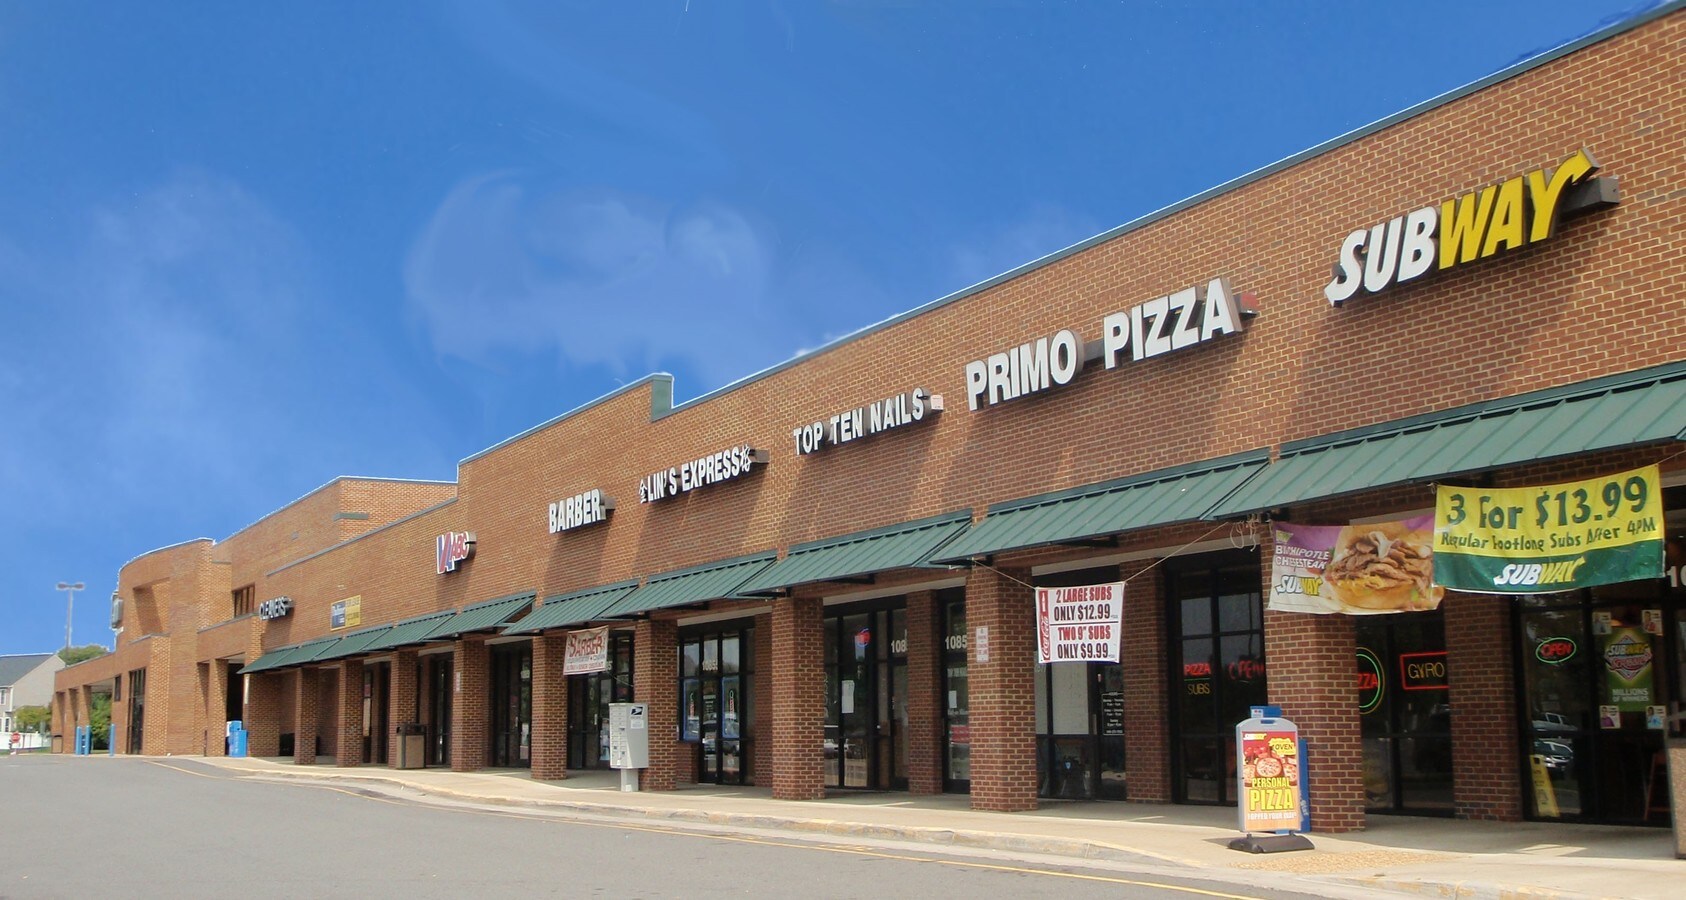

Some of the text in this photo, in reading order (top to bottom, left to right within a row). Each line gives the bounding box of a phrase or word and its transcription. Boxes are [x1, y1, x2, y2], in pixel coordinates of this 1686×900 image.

[1324, 148, 1597, 307] SUBWAY
[965, 277, 1238, 411] PRIMO PIZZA
[793, 387, 925, 455] TOP TEN NAILS
[647, 446, 740, 502] LIN'S EXPRESS
[549, 488, 604, 534] BARBER
[1446, 475, 1648, 530] 3 For $13.99
[1440, 531, 1489, 549] Regular
[1550, 532, 1581, 549] Subs
[1626, 517, 1656, 536] 4PM
[450, 531, 470, 561] ABC
[1493, 556, 1586, 586] SUBWAY
[1055, 586, 1113, 603] 2 LARGE SUBS
[1053, 603, 1111, 621] ONLY $12.99
[944, 634, 967, 650] 1085
[1057, 626, 1077, 641] TWO
[1088, 625, 1111, 640] SUBS
[890, 639, 907, 653] 108
[1057, 642, 1109, 660] ONLY $9.99
[1540, 642, 1573, 657] OPEN
[1183, 662, 1211, 676] PIZZA
[1407, 662, 1445, 679] GYRO
[1186, 682, 1211, 695] SUBS
[1357, 671, 1378, 690] ZZA
[1612, 687, 1649, 696] MILLIONS
[1251, 776, 1290, 788] PERSONAL
[1249, 788, 1294, 811] PIZZA
